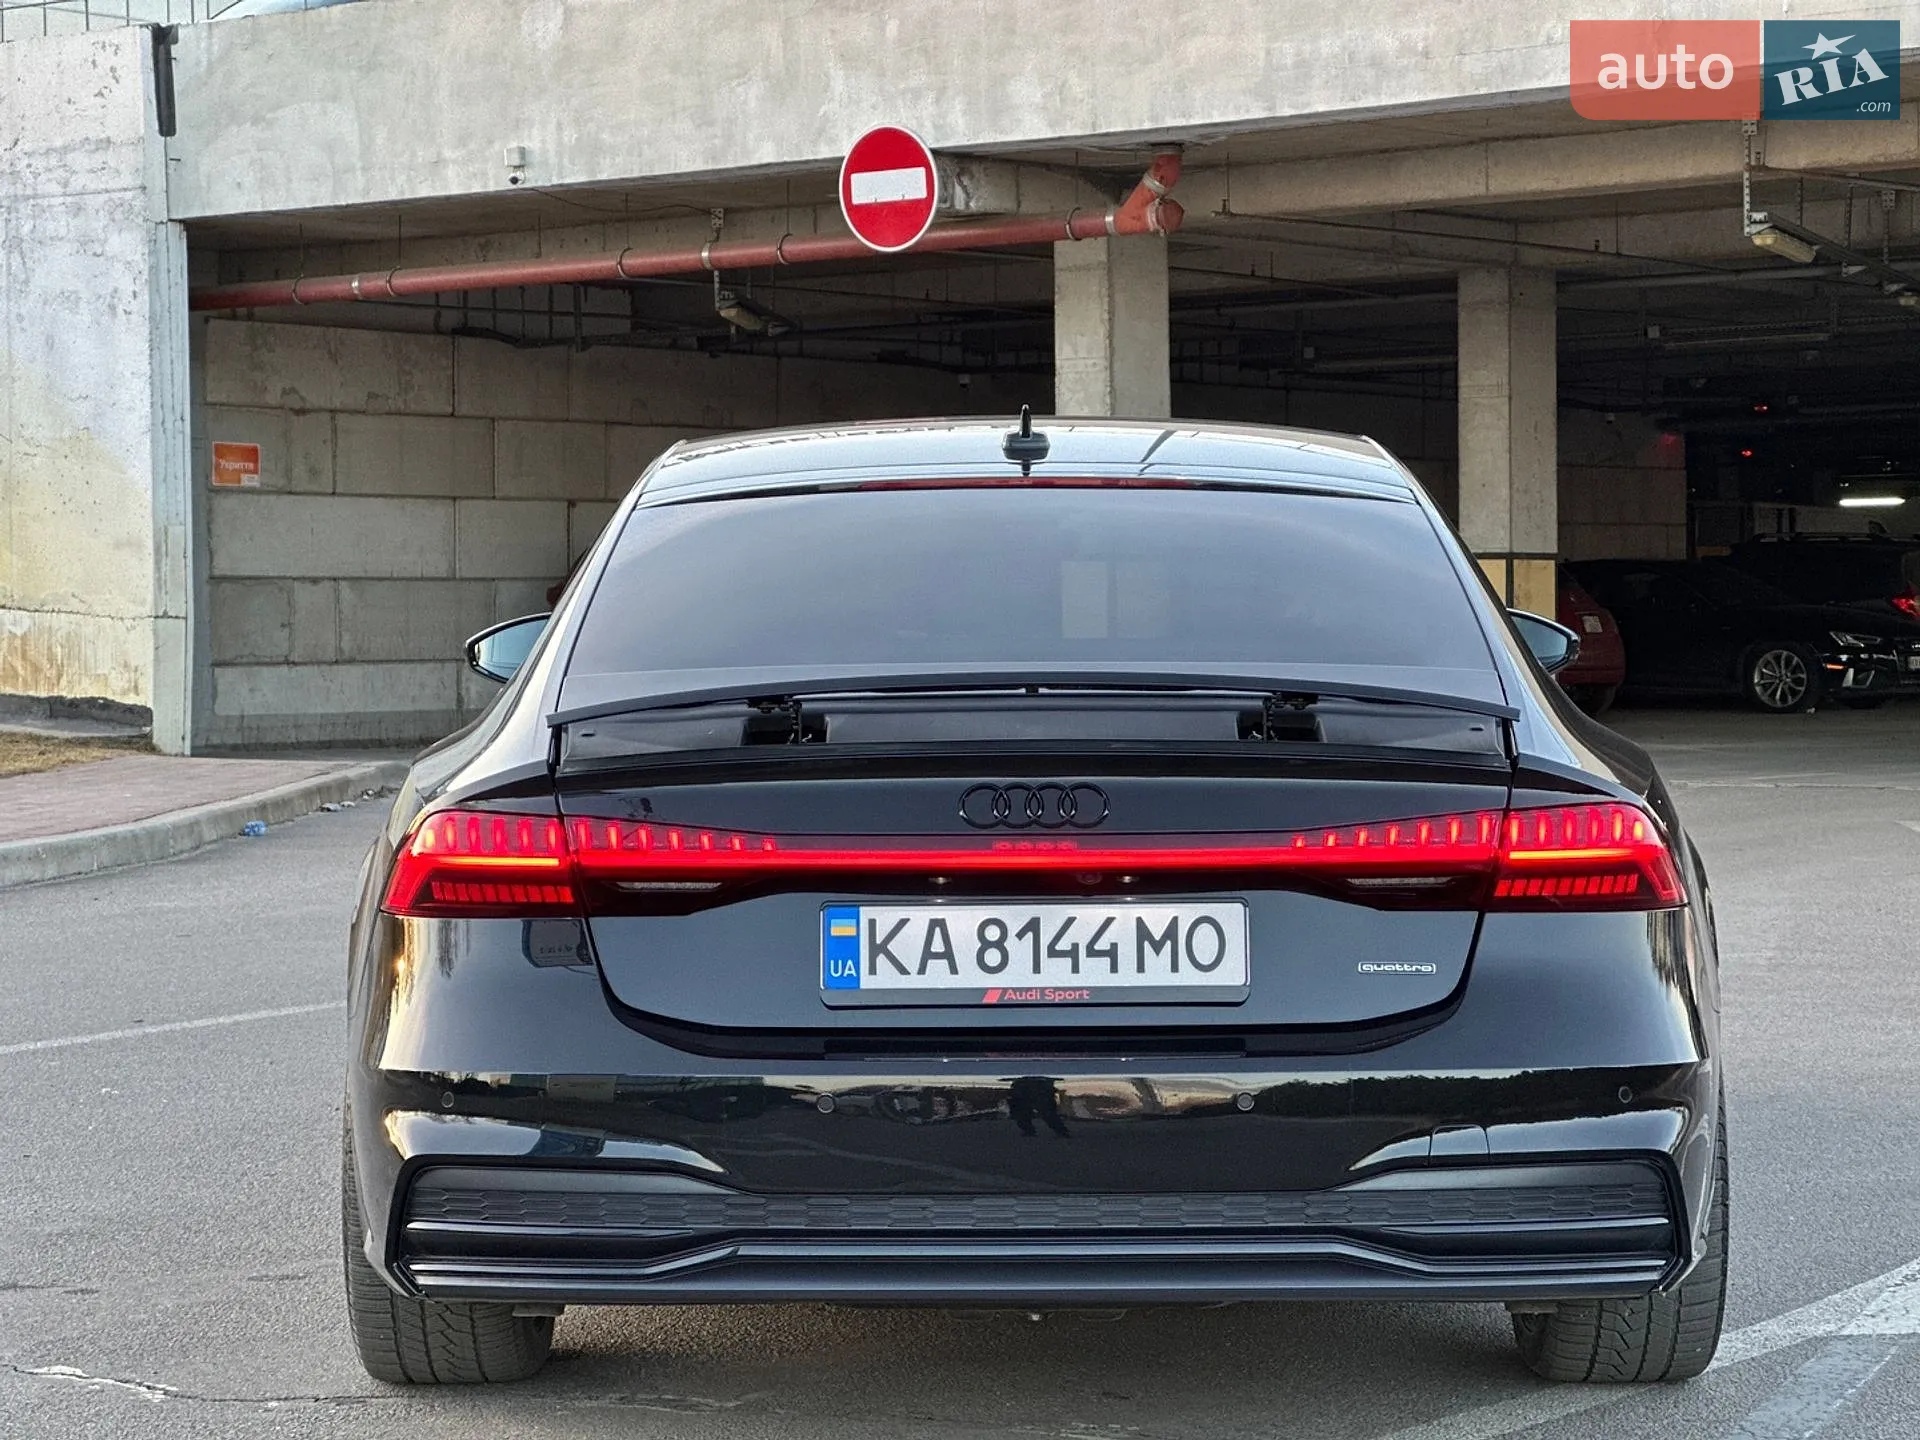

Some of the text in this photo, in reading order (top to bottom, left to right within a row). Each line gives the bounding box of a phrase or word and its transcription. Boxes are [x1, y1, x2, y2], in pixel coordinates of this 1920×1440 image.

[867, 914, 1227, 976] KA 8144 MO
[830, 960, 857, 977] UA
[1361, 963, 1433, 973] quattro
[1004, 988, 1090, 1003] Audi Sport
